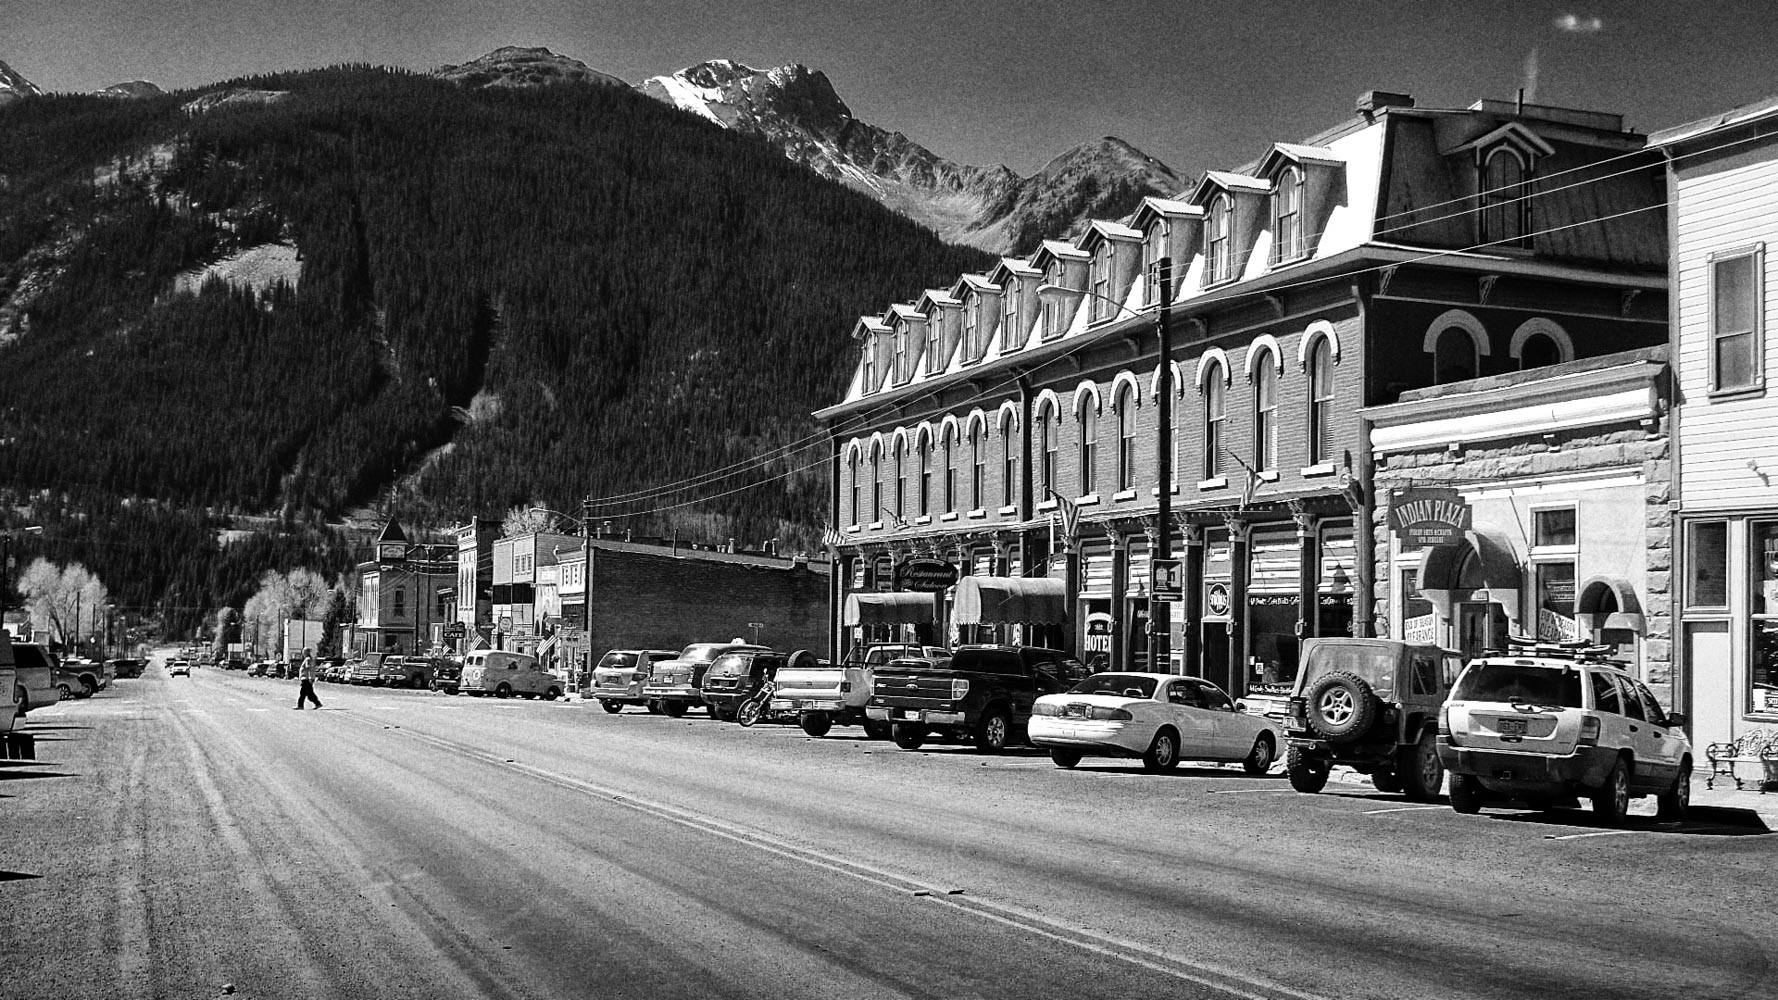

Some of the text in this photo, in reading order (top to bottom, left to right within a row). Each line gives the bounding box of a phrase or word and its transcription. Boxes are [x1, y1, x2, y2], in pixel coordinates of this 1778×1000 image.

[1395, 499, 1466, 529] INDIAN PLAZA
[900, 565, 952, 578] Restaurant
